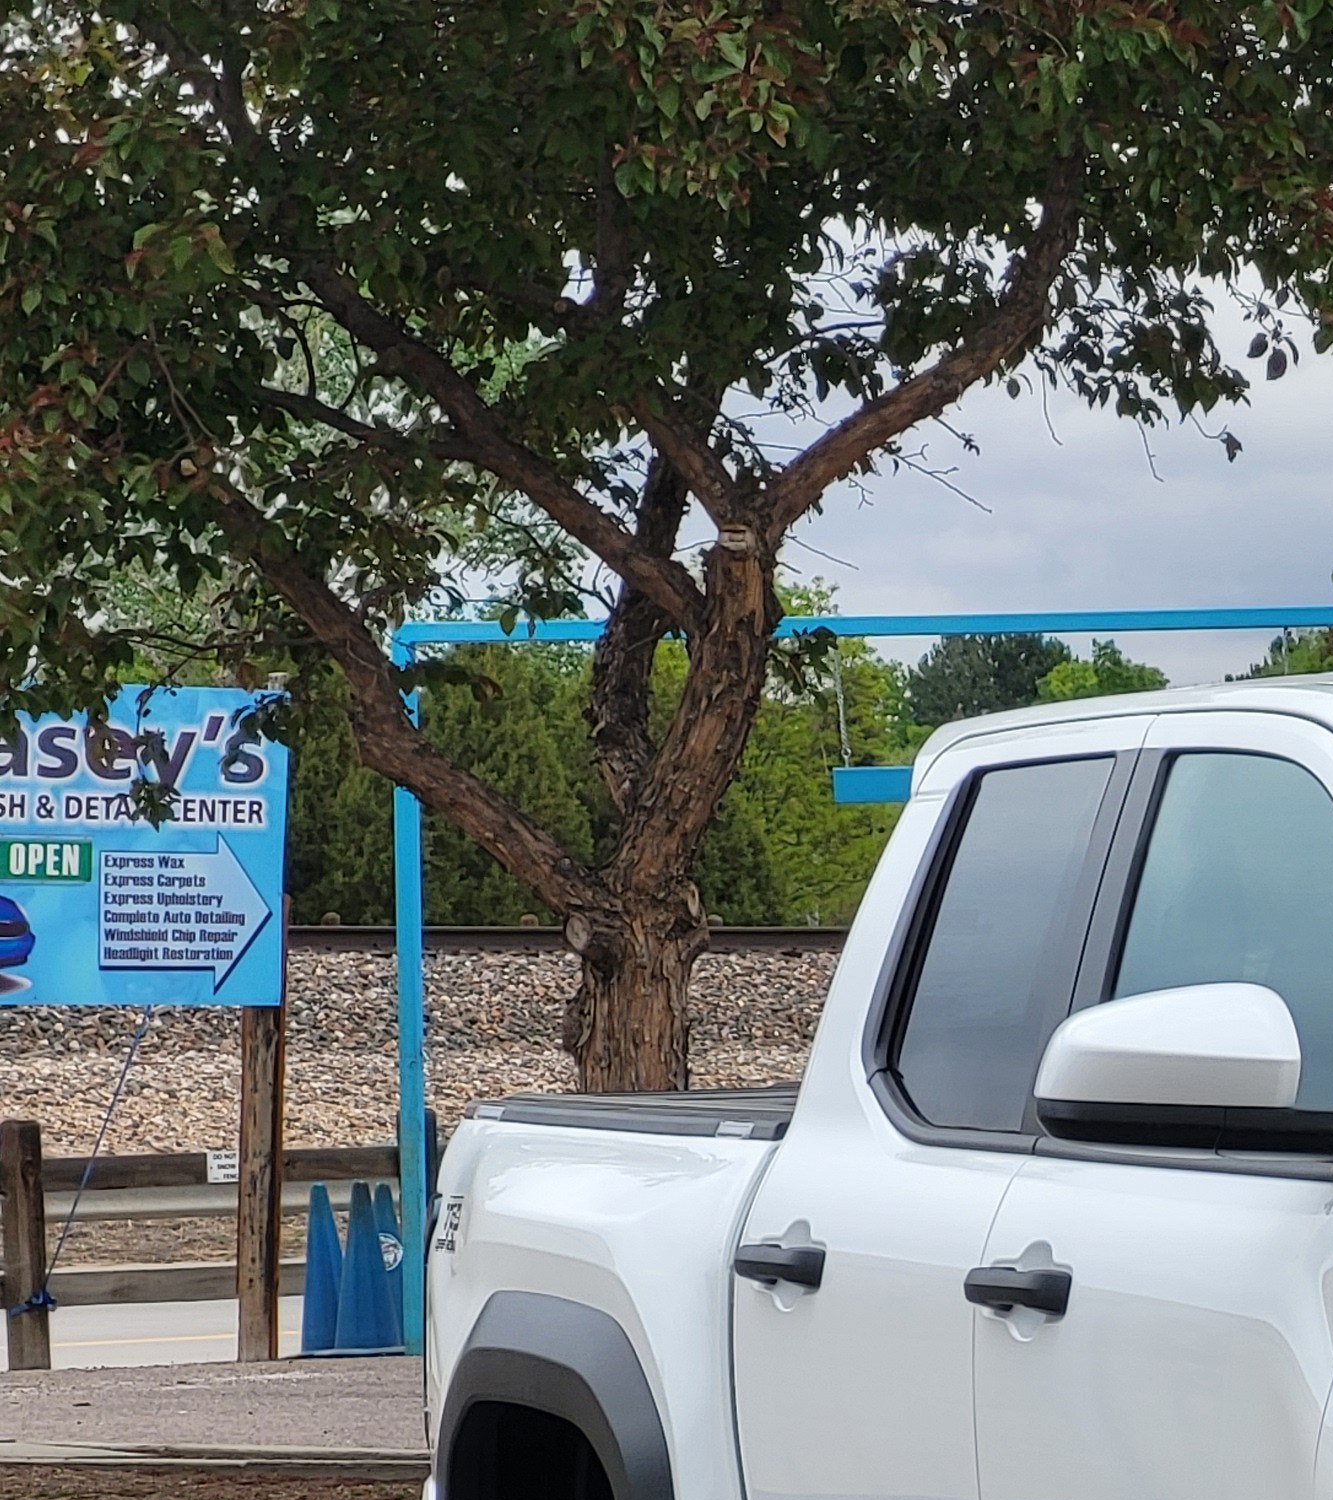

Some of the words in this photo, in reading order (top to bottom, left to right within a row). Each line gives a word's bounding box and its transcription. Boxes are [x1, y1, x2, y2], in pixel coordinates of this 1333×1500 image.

[36, 794, 54, 819] &
[9, 843, 80, 877] OPEN
[104, 854, 154, 870] Express
[158, 856, 185, 869] Wax
[104, 873, 154, 888] Express
[157, 874, 206, 889] Carpets
[104, 891, 154, 906] Express
[157, 892, 223, 908] Upholstery
[104, 909, 159, 925] Complete
[163, 911, 191, 924] Auto
[195, 911, 246, 926] Detailing
[104, 928, 168, 942] Windshield
[172, 929, 196, 943] Chip
[200, 929, 238, 943] Repair
[104, 946, 159, 961] Headlight
[162, 947, 234, 960] Restoration
